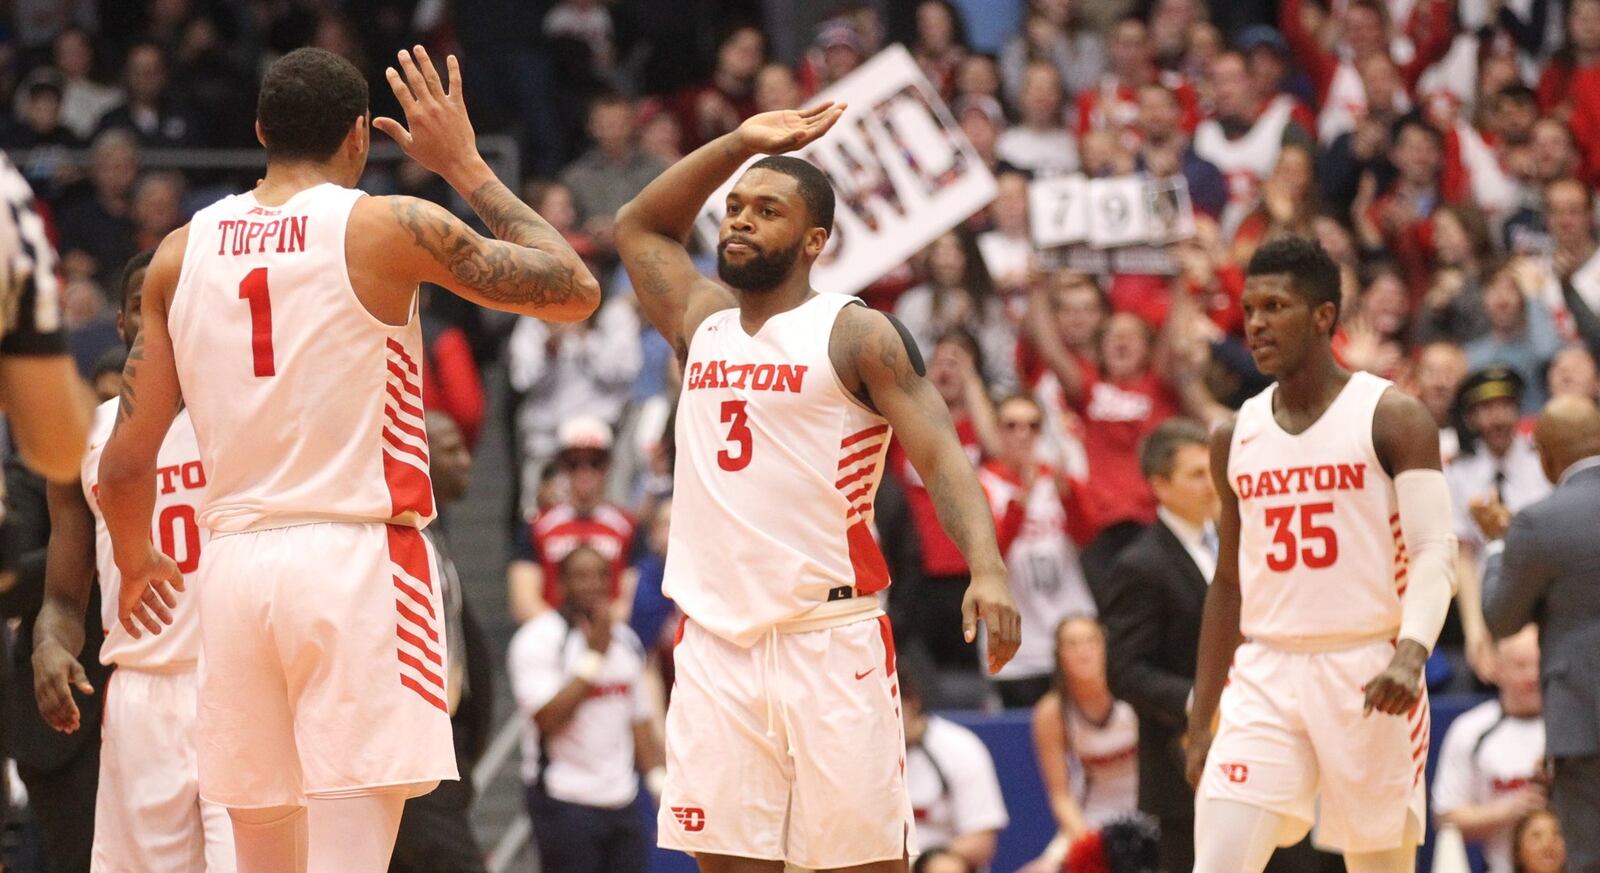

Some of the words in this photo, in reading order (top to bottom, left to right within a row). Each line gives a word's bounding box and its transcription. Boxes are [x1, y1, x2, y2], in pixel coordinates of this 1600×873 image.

[218, 216, 308, 256] TOPPIN
[238, 267, 275, 377] 1
[688, 360, 808, 393] DAYTON
[717, 400, 753, 472] 3
[1236, 464, 1366, 501] DAYTON
[151, 504, 202, 575] 0
[1264, 502, 1338, 573] 35
